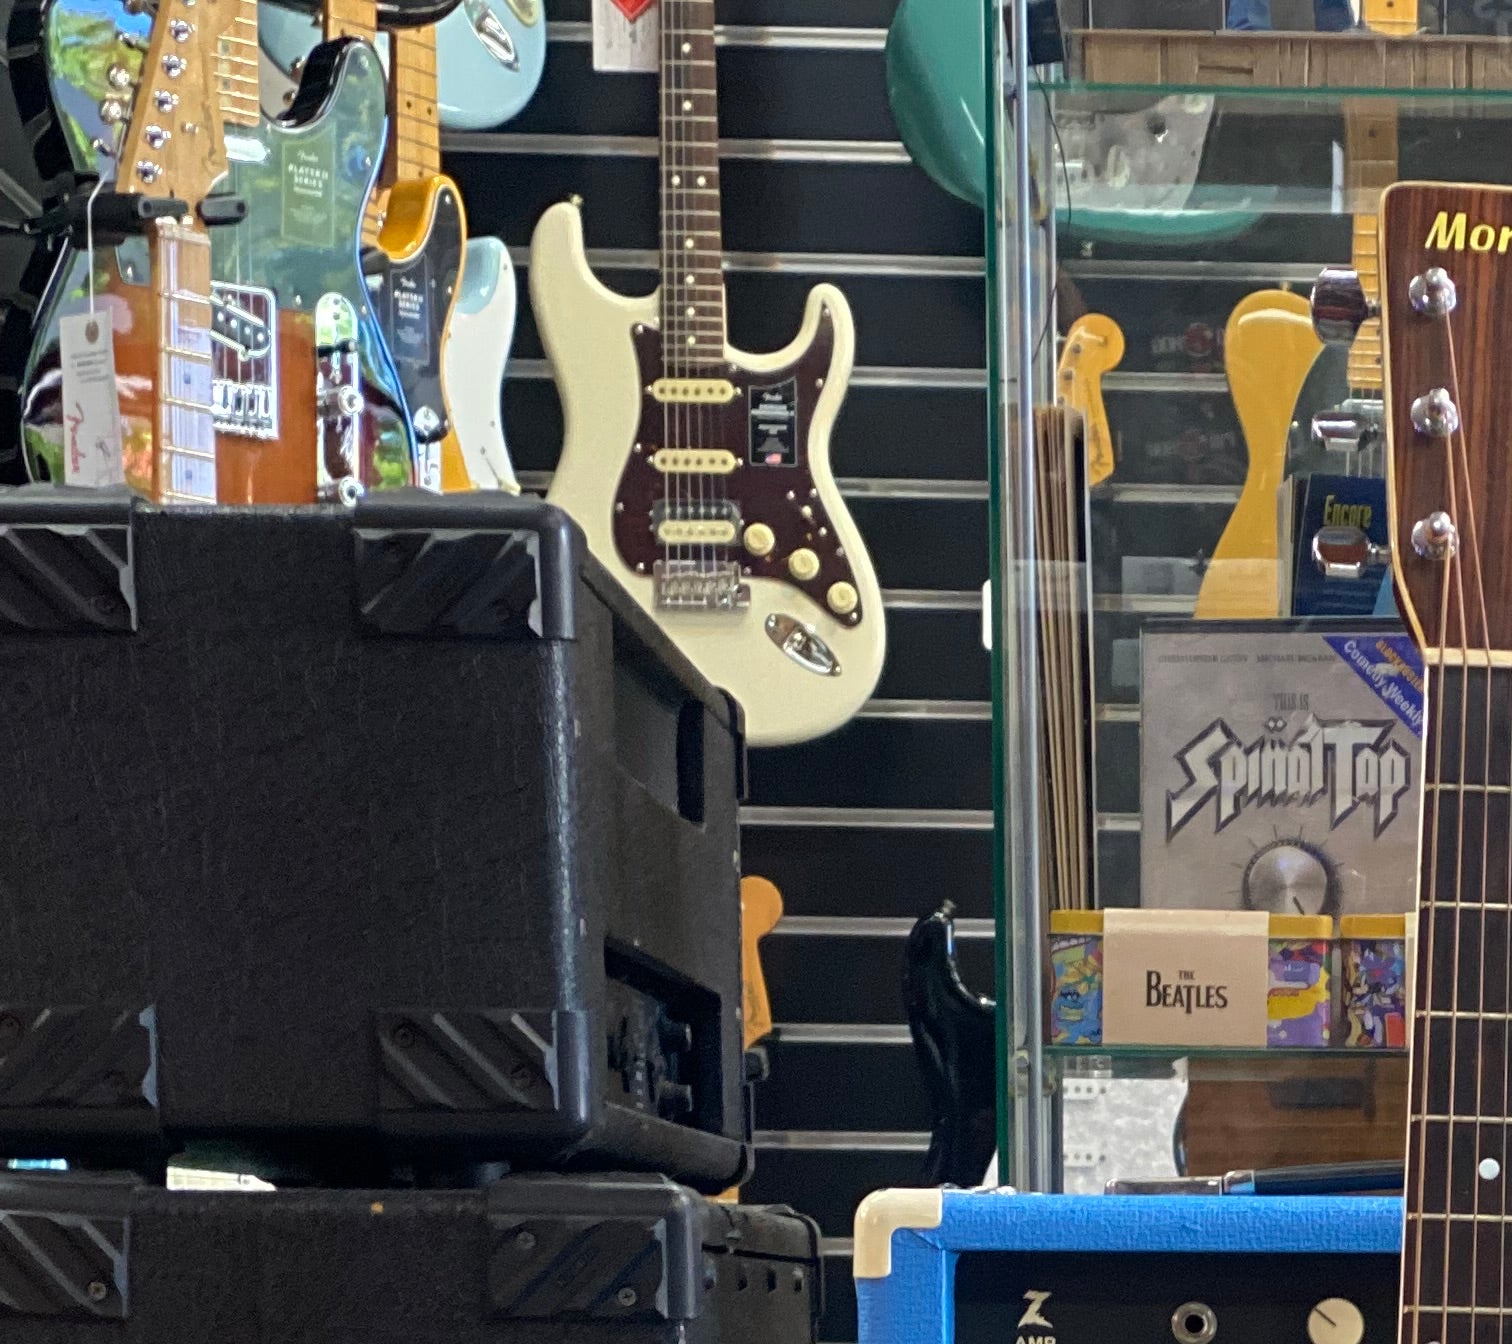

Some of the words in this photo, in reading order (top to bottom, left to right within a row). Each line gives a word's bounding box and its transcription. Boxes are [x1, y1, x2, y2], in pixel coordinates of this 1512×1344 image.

[1323, 494, 1372, 528] Encore
[1322, 718, 1411, 841] Tap
[1146, 970, 1229, 1014] BEATLES
[1178, 969, 1196, 981] THE
